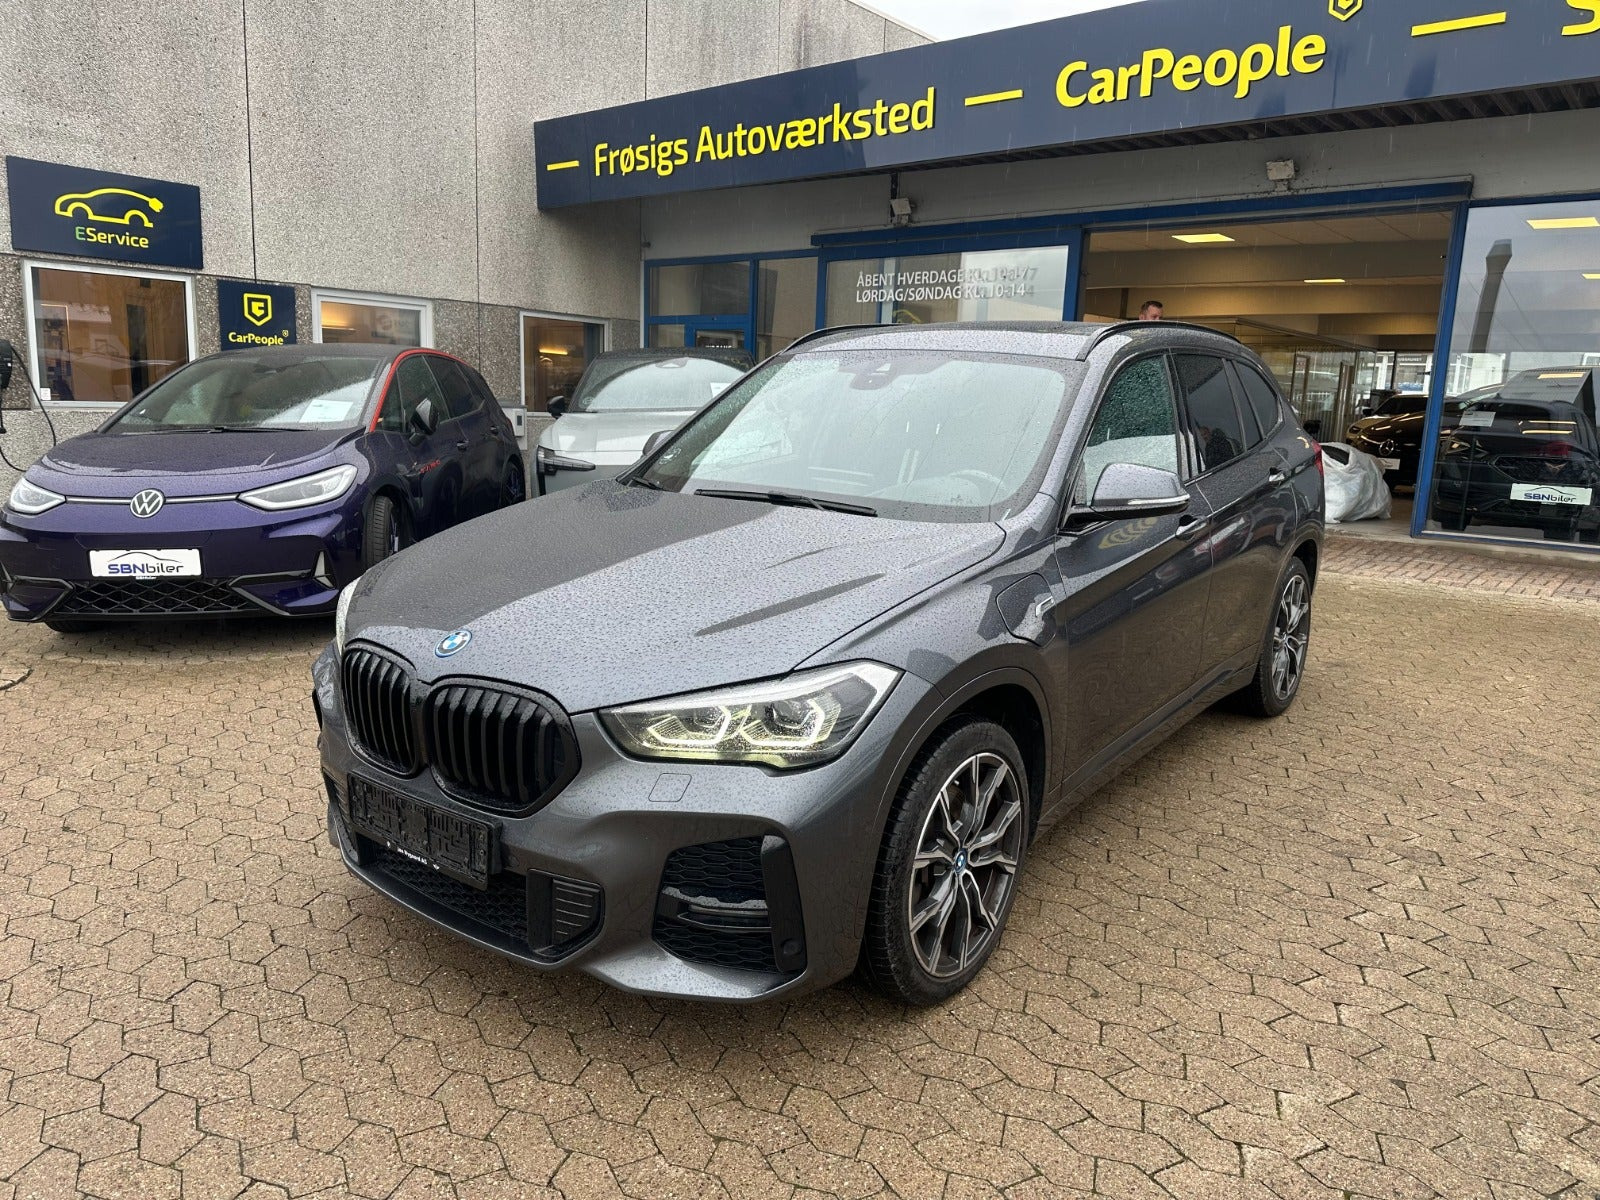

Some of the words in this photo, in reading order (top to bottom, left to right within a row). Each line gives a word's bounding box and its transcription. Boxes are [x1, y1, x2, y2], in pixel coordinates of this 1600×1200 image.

[1055, 25, 1327, 107] CarPeople
[594, 133, 690, 177] Frøsigs
[695, 86, 935, 163] Autoværksted
[75, 226, 149, 249] EService
[856, 271, 895, 287] ÅBENT
[897, 268, 964, 285] HVERDAGE
[856, 285, 961, 303] LØRDAG/SØNDAG
[228, 331, 284, 347] CarPeople
[107, 563, 184, 575] SBNbiler
